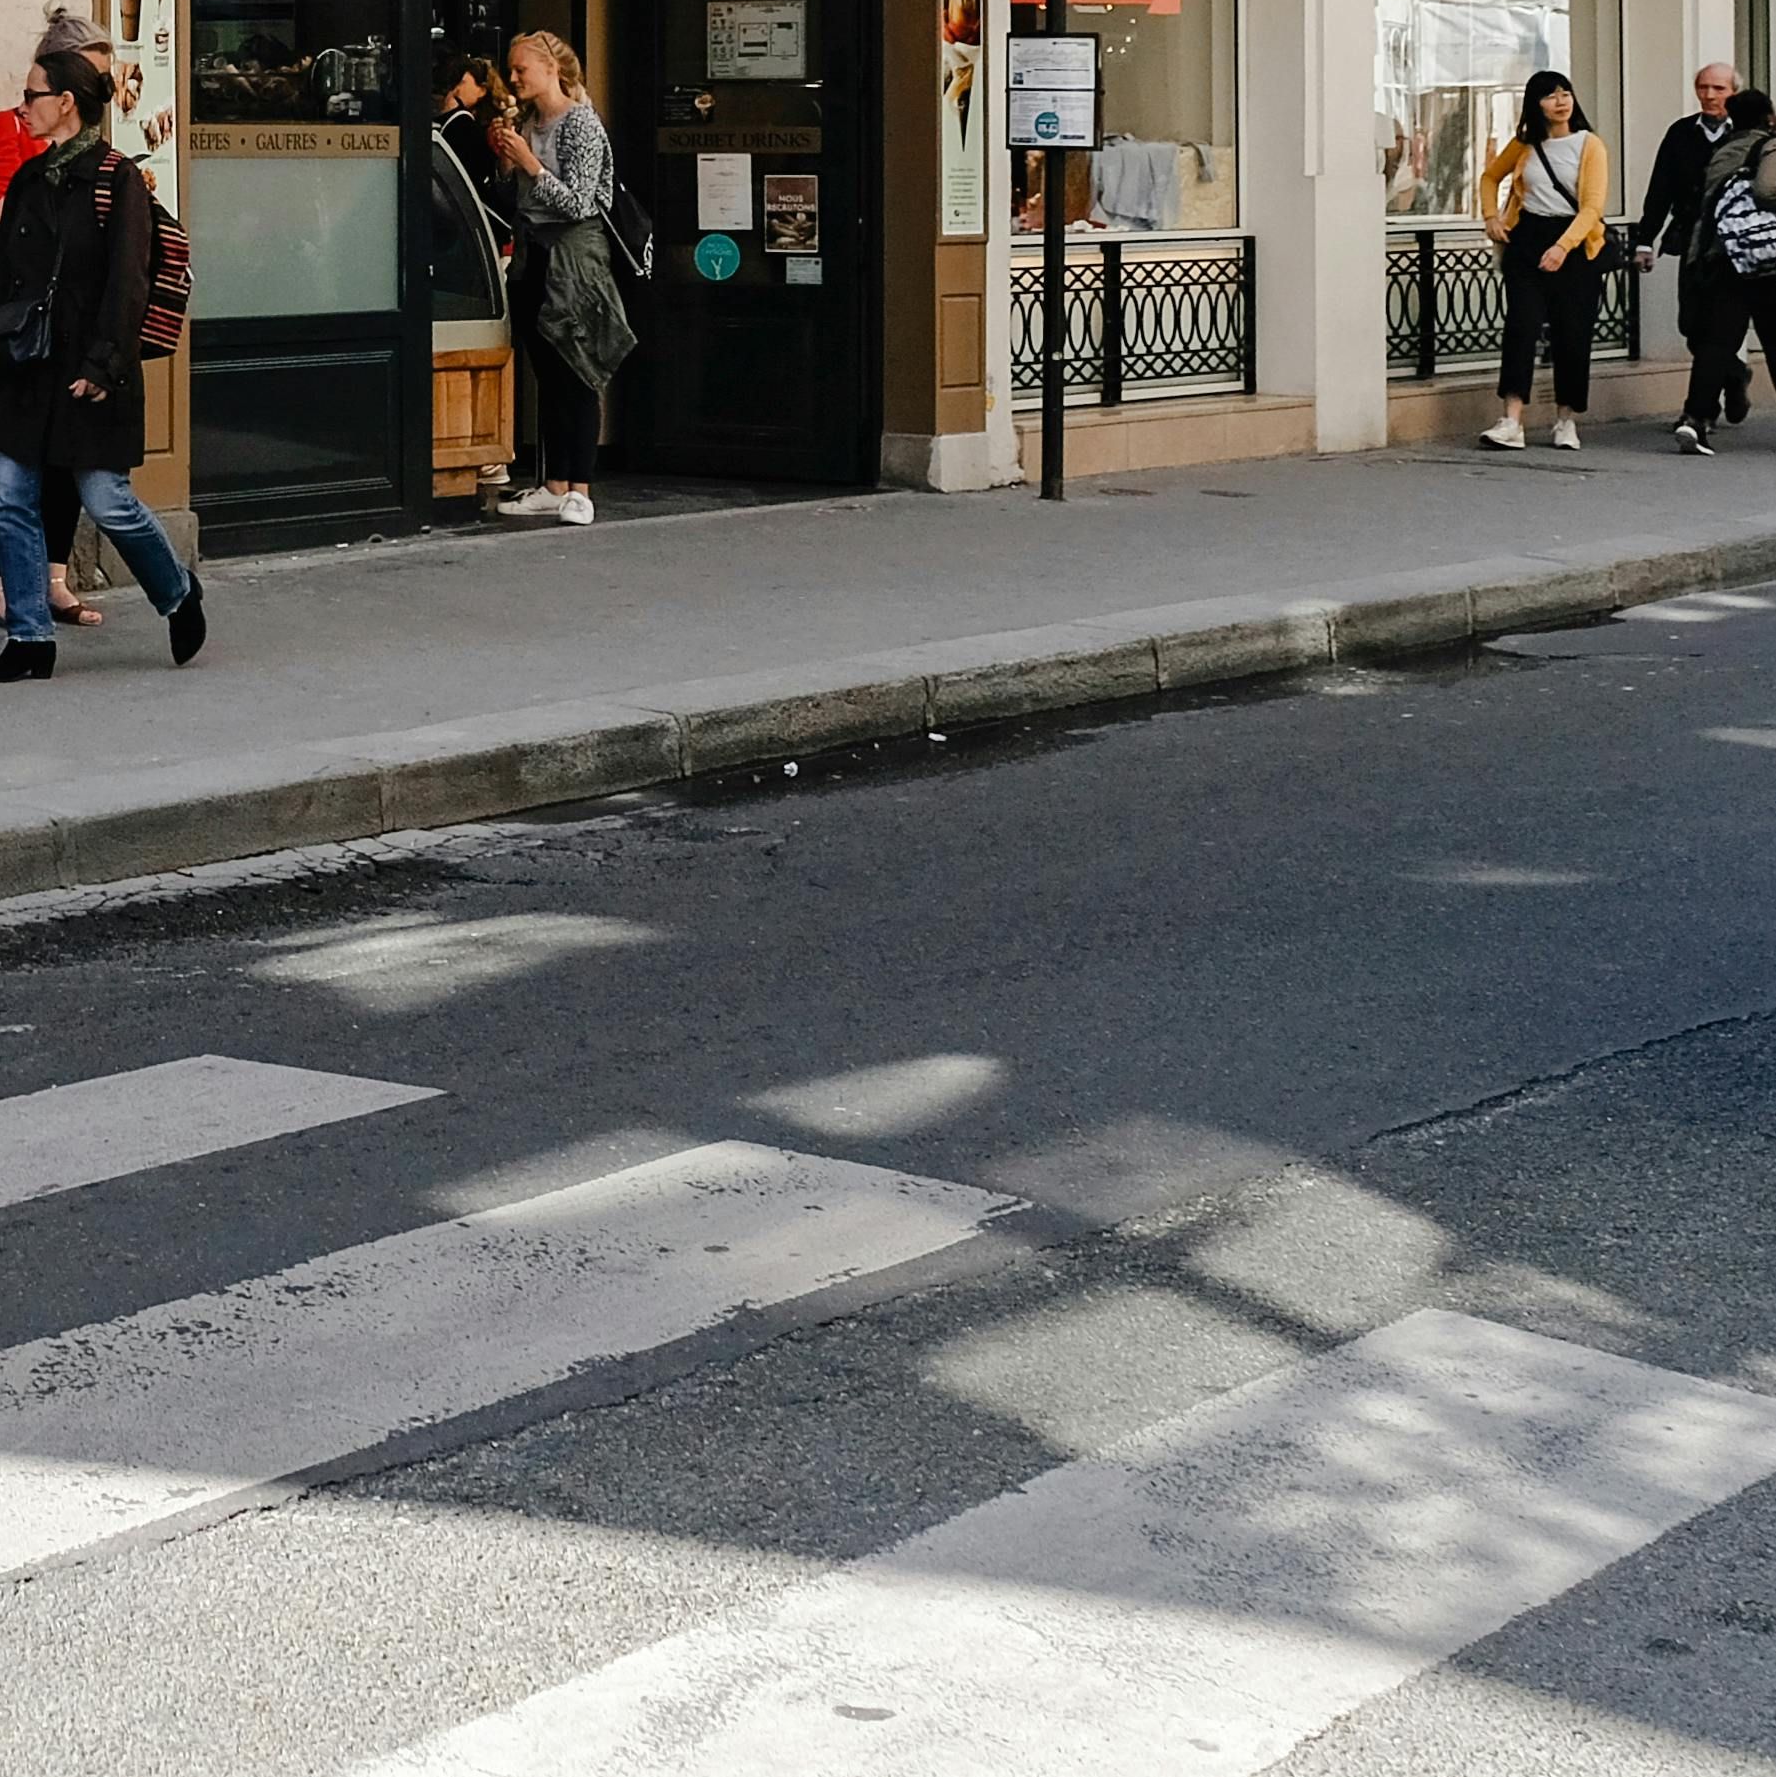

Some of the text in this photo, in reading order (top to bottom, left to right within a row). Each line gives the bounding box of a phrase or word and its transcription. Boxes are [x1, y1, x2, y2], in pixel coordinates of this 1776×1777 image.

[255, 131, 318, 151] GAUFRES
[340, 132, 391, 151] GLACES
[669, 132, 810, 148] SORBET DRINKS
[778, 194, 804, 203] NOUS
